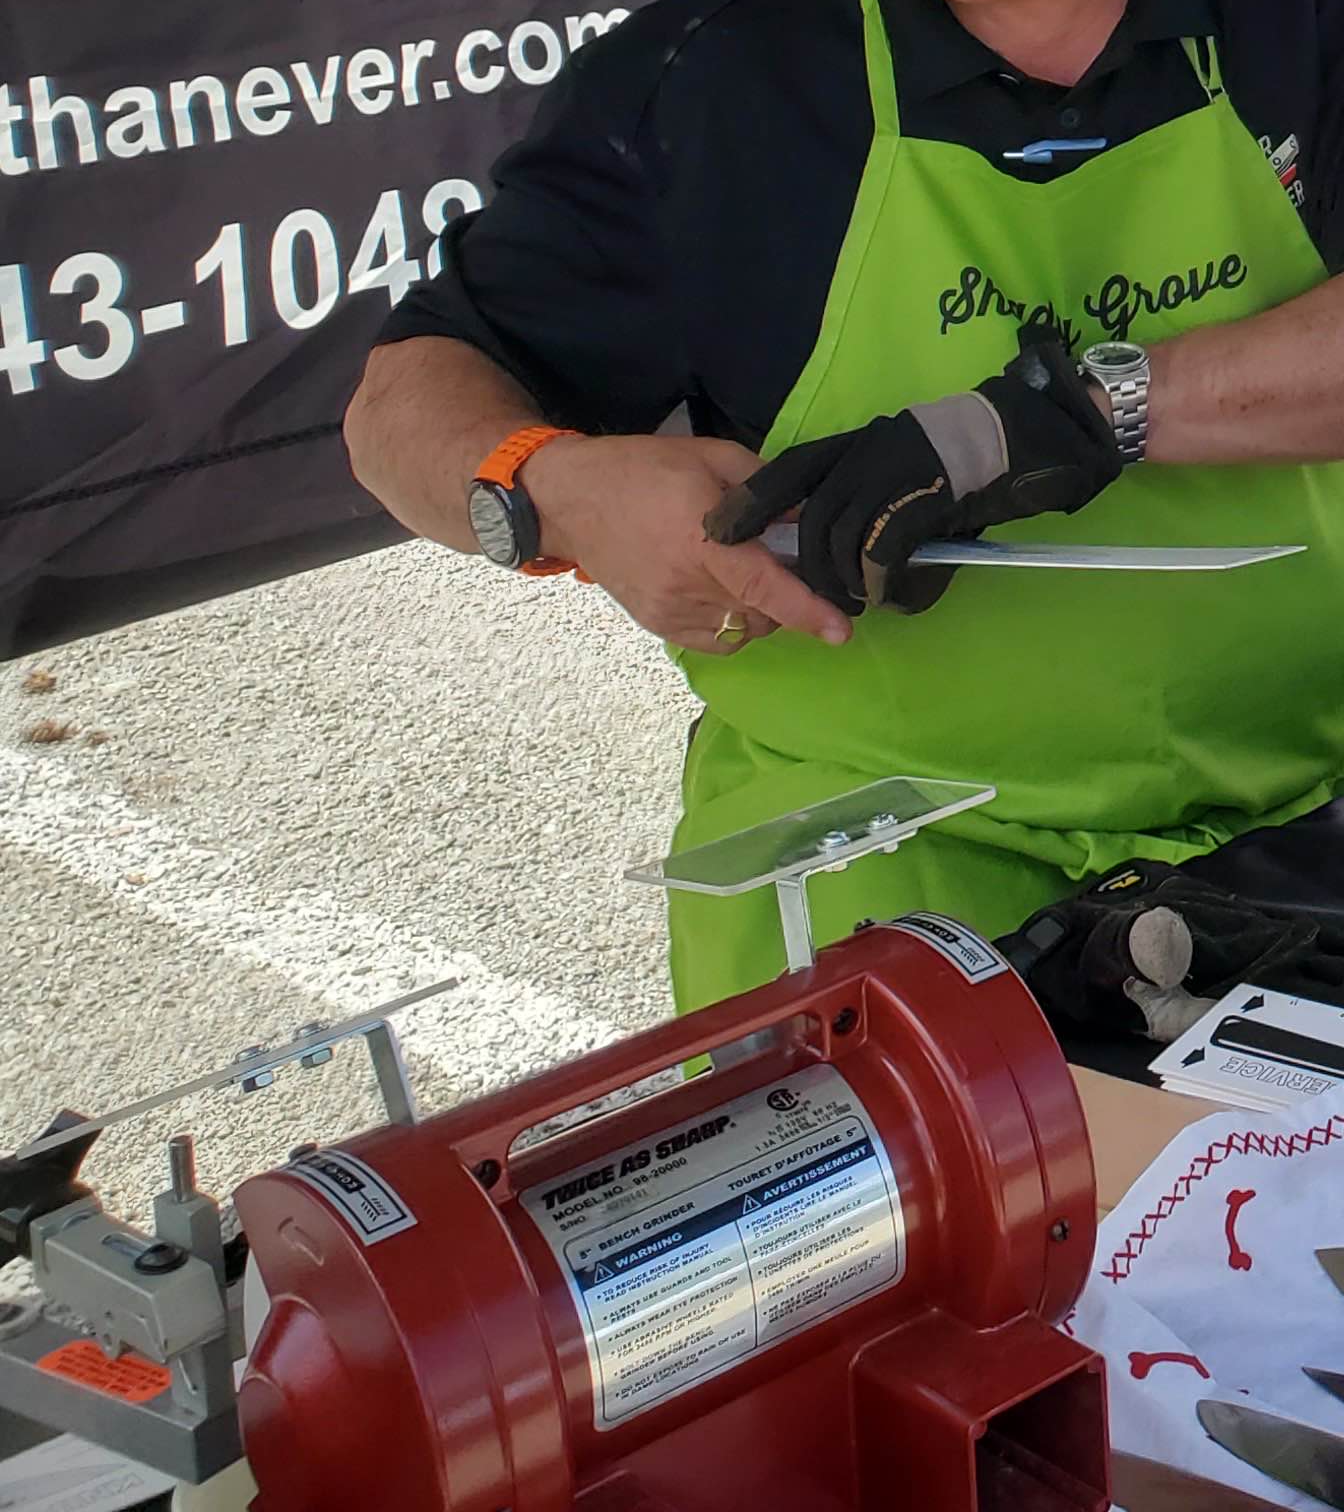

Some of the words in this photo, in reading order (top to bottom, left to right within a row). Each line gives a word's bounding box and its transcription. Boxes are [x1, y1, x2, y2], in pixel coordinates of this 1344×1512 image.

[1085, 253, 1248, 342] Grove
[1220, 1056, 1336, 1096] ERVICE
[619, 1149, 651, 1177] AS
[727, 1165, 771, 1190] TOURET
[763, 1145, 865, 1200] AVERTISSEMENT
[552, 1197, 598, 1222] MODEL
[598, 1226, 640, 1250] BENCH
[642, 1201, 694, 1229] GRINDER
[750, 1213, 772, 1226] POUR
[615, 1232, 682, 1267] WARNING
[615, 1271, 647, 1291] REDUCE
[648, 1262, 668, 1275] RISK
[681, 1242, 709, 1259] INJURY
[604, 1288, 626, 1302] READ
[628, 1263, 680, 1291] INSTRUCTION
[681, 1248, 713, 1266] MANUAL
[609, 1299, 640, 1317] ALWAYS
[642, 1290, 658, 1302] USE
[660, 1274, 692, 1293] GUARDS
[694, 1265, 710, 1277] AND
[712, 1256, 732, 1268] TOOL
[614, 1320, 646, 1339] ALWAYS
[647, 1308, 670, 1322] WEAR
[673, 1300, 687, 1311] EYE
[689, 1276, 737, 1303] PROTECTION
